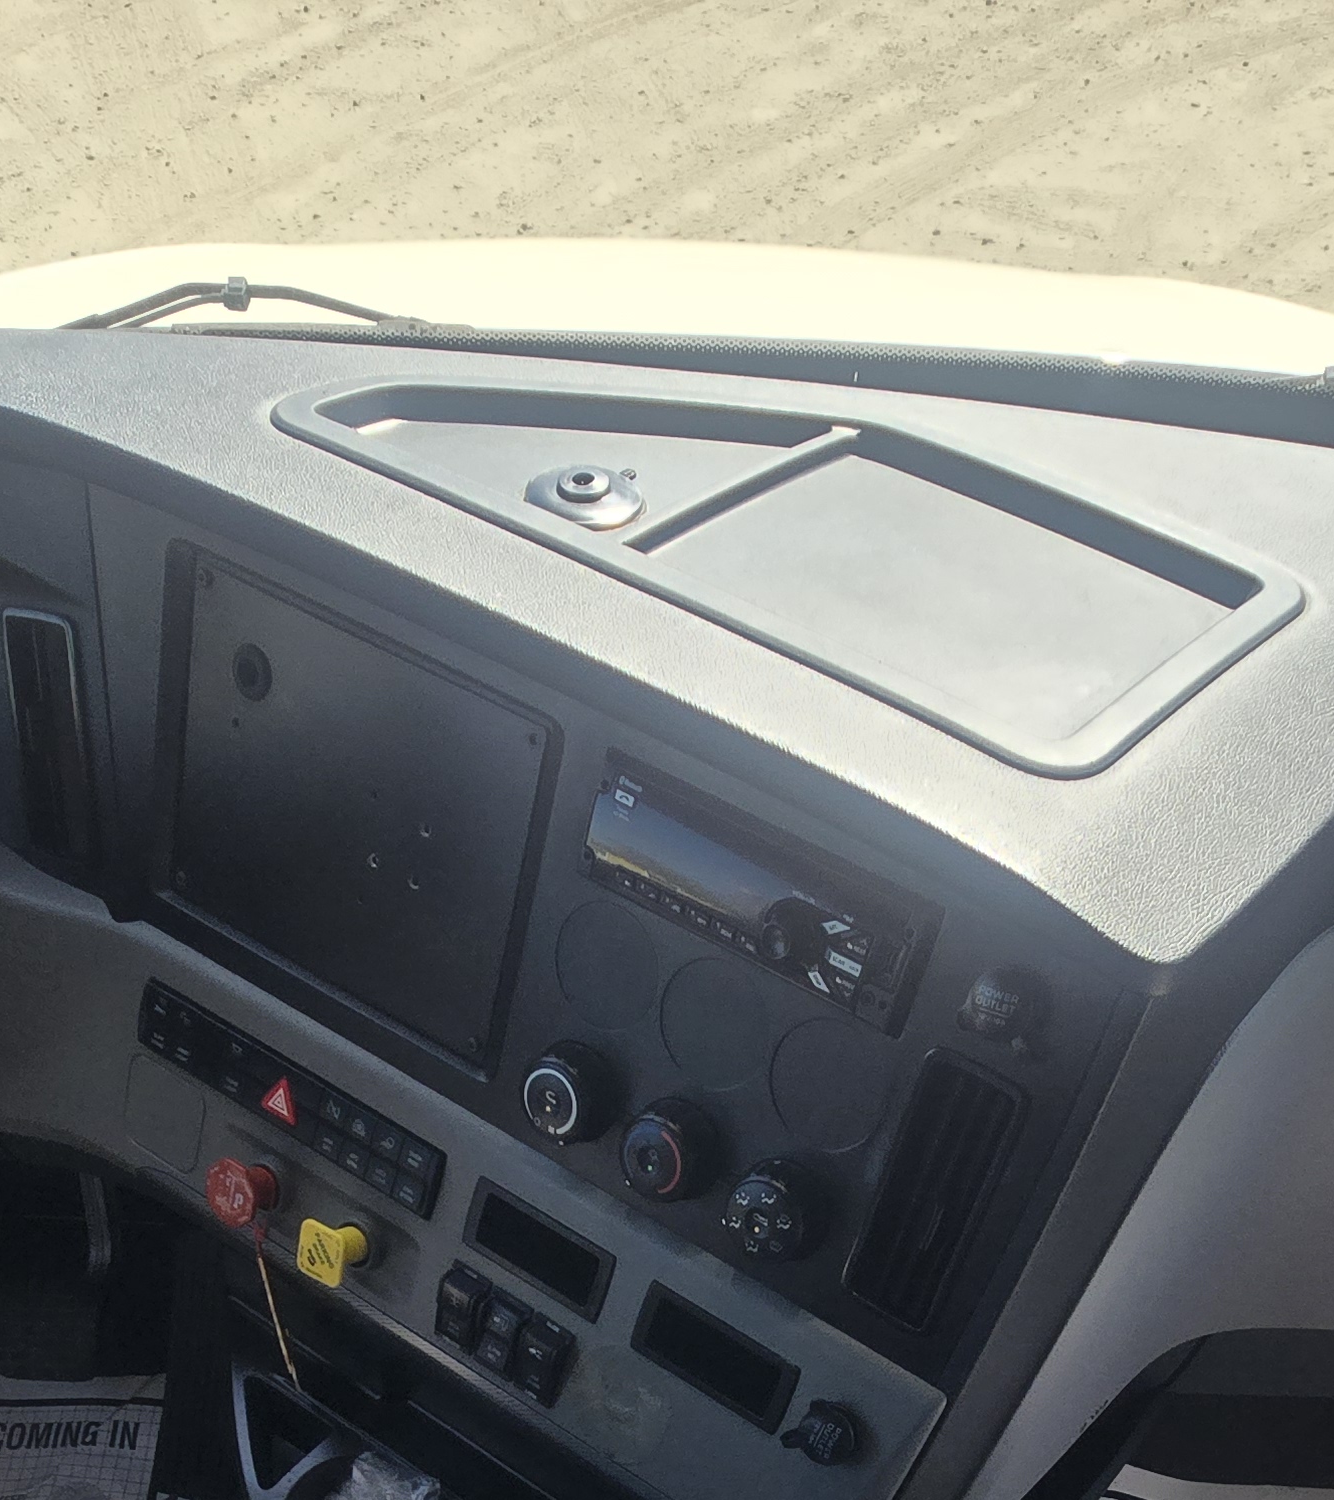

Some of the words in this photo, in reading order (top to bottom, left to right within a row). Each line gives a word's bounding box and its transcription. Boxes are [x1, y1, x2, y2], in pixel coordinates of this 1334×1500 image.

[975, 984, 1019, 1004] POWER
[975, 995, 1016, 1015] OUTLET
[109, 1419, 141, 1450] IN
